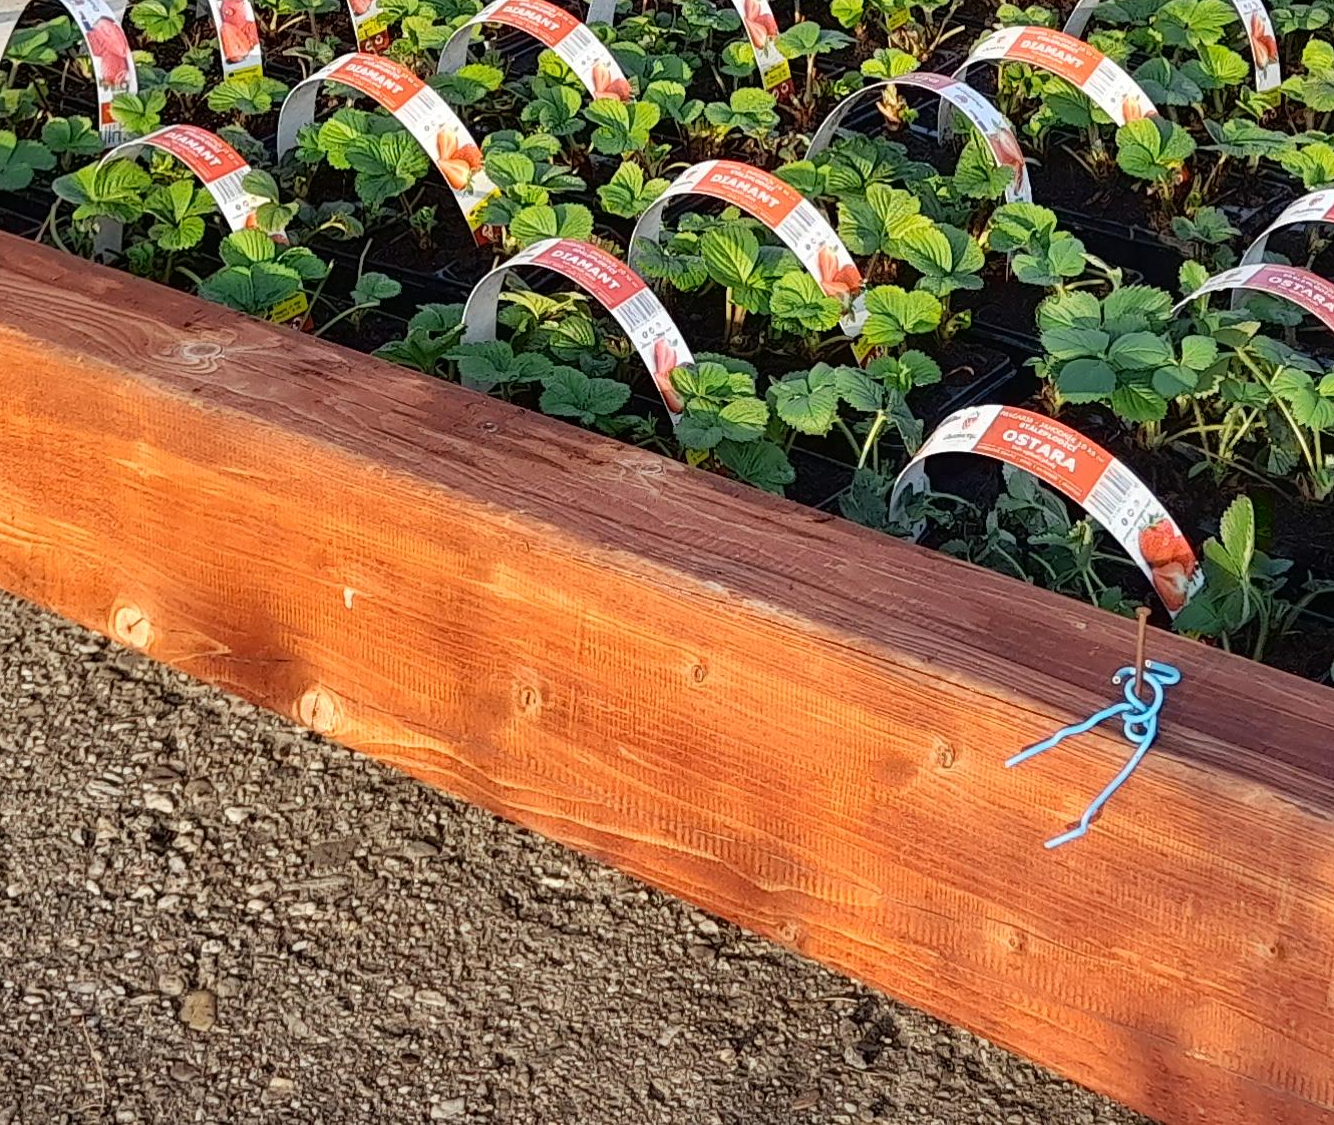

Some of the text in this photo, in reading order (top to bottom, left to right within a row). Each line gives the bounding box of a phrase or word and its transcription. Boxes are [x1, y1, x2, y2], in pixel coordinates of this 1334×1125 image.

[503, 4, 560, 32] DIAMANT
[1019, 39, 1084, 69] DIAMANT
[346, 63, 403, 96] DIAMANT
[709, 174, 780, 208] DIAMANT
[552, 250, 621, 290] DIAMANT
[1268, 275, 1334, 313] OSTARA
[1002, 428, 1076, 474] OSTARA
